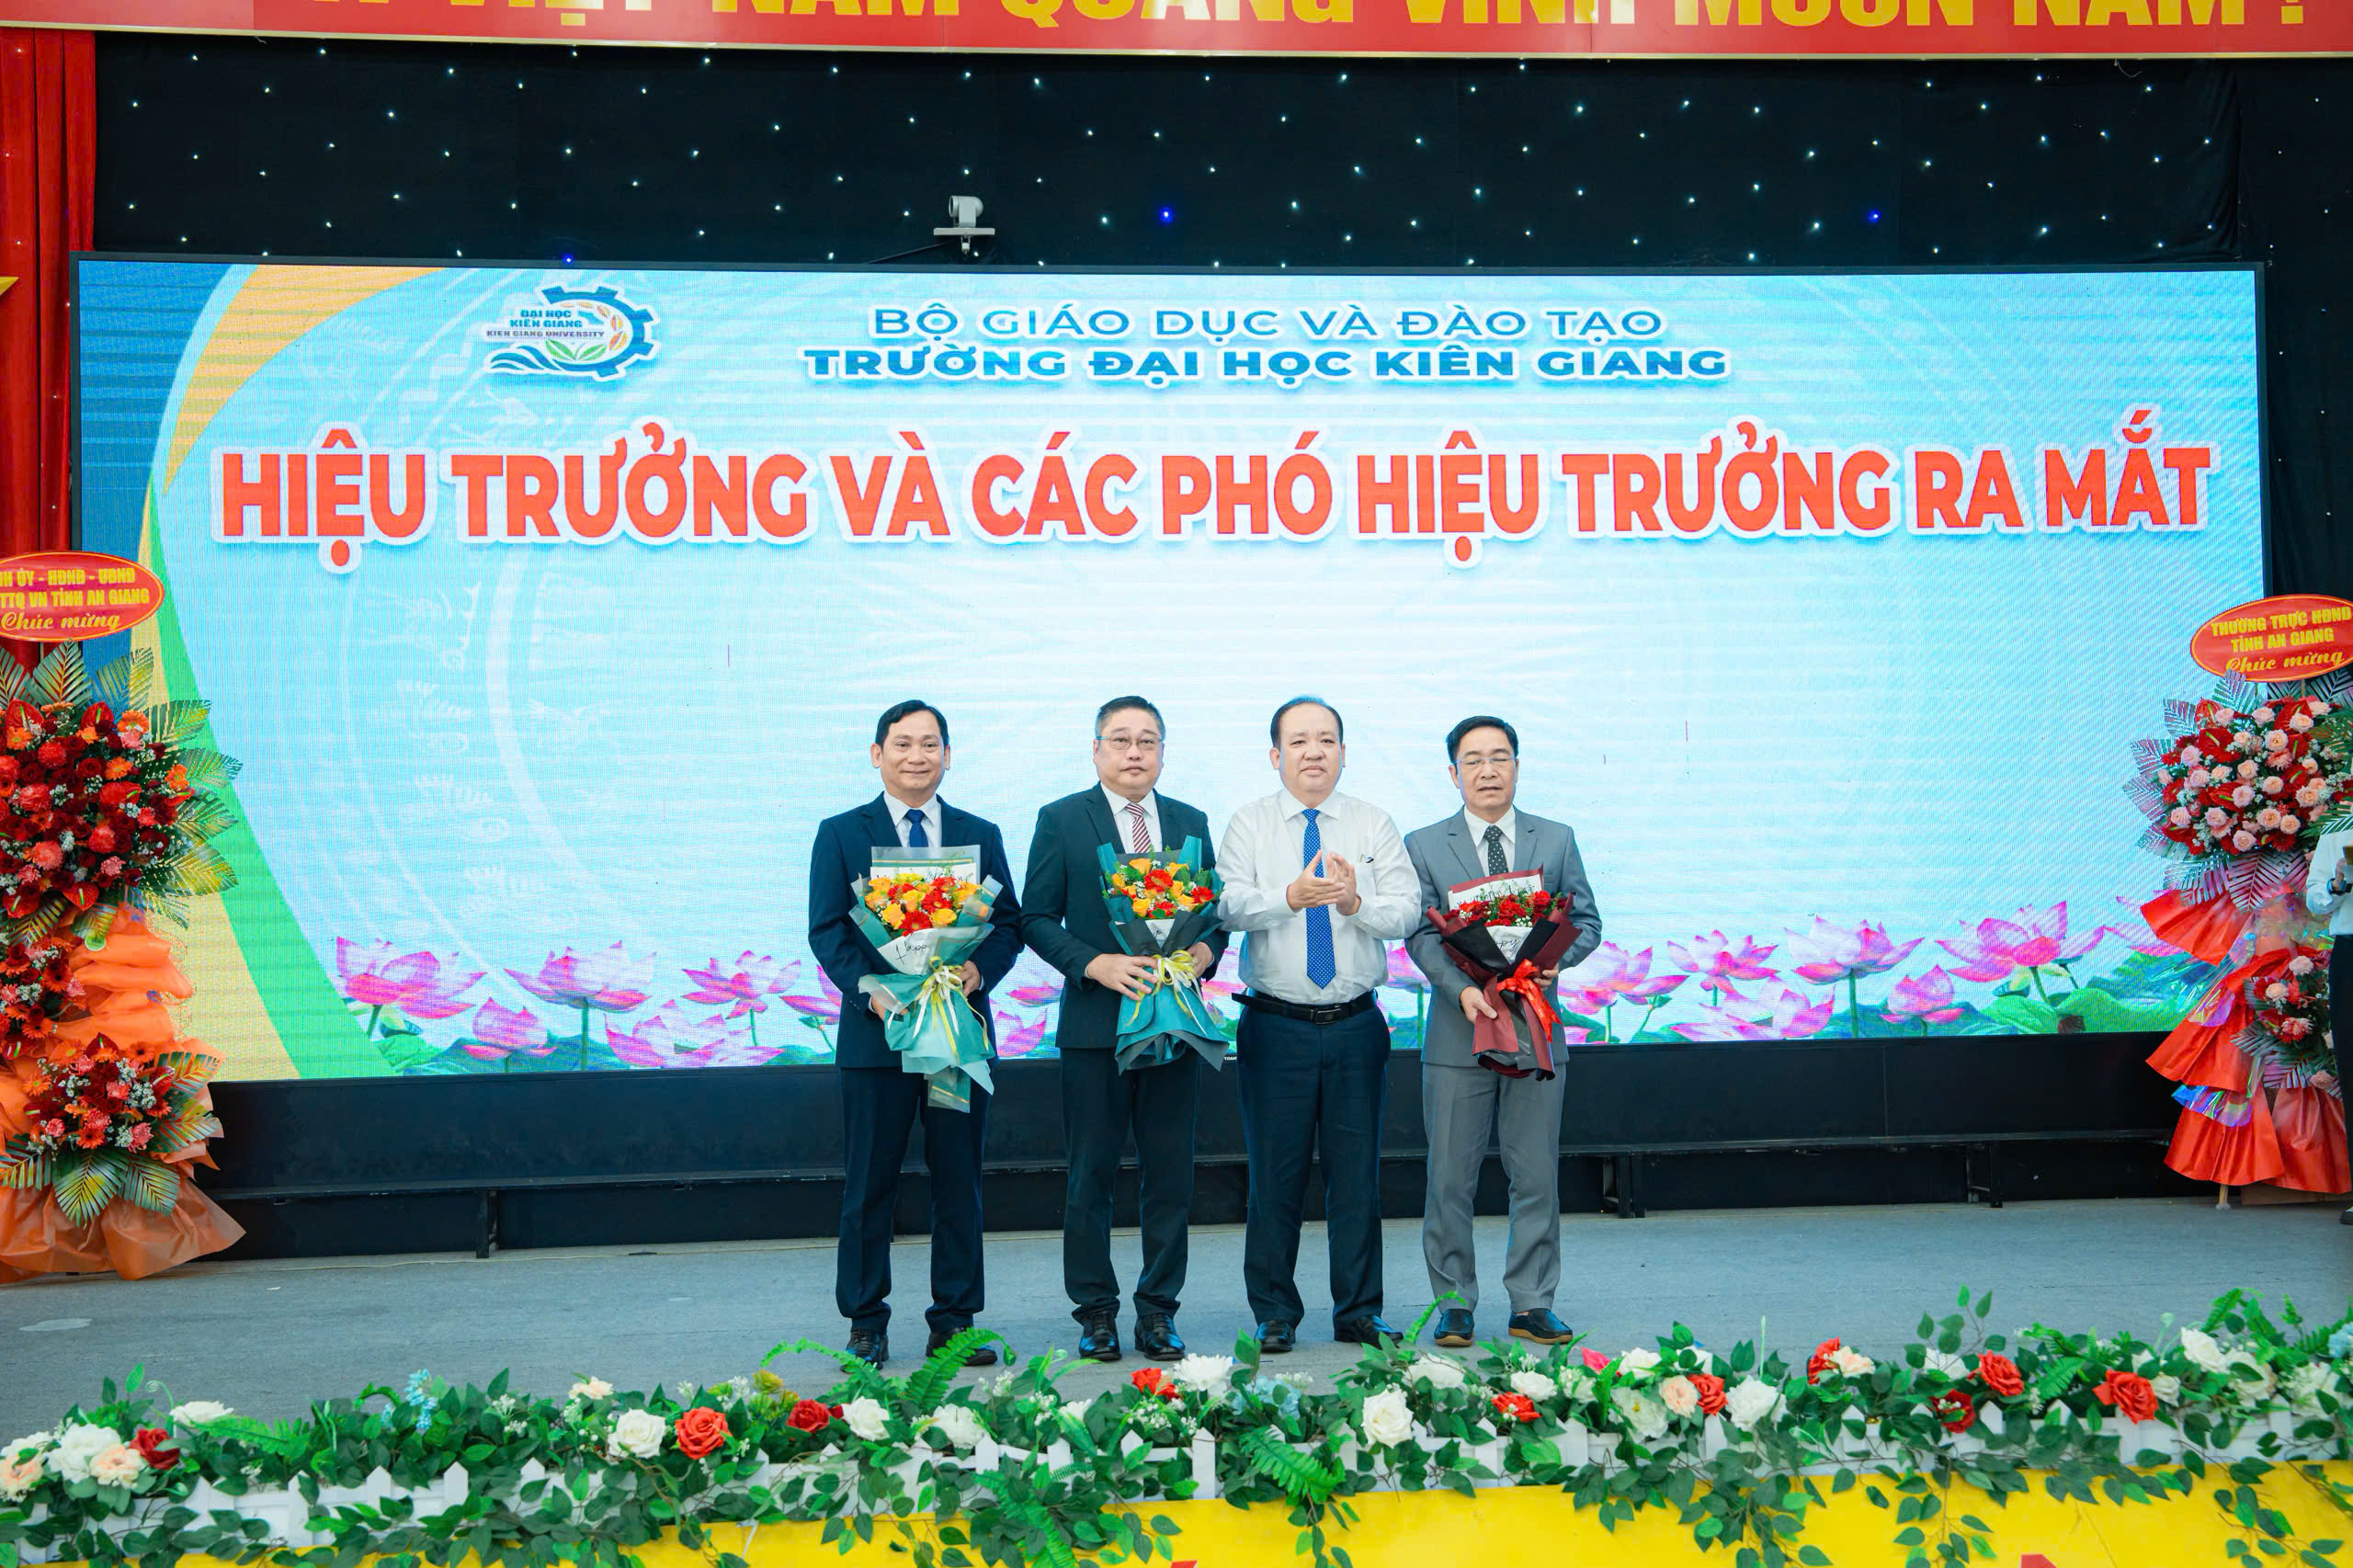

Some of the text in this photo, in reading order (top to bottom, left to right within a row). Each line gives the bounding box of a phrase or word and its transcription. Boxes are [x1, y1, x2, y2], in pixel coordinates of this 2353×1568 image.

[542, 319, 583, 328] GIANG
[875, 302, 1662, 343] BỘ GIÁO DỤC VÀ ĐÀO TẠO
[804, 344, 1726, 385] TRƯỜNG ĐẠI HỌC KIÊN GIANG
[222, 409, 2211, 567] HIỆU TRƯỞNG VÀ CÁC PHÓ HIỆU TRƯỞNG RA MẮT
[28, 591, 47, 608] VN
[86, 589, 105, 606] AN
[108, 588, 150, 605] GIANG
[1, 611, 120, 631] Chúc mừng
[2211, 617, 2267, 636] THƯỜNG
[2270, 610, 2308, 630] TRỰC
[2268, 632, 2286, 648] AN
[2290, 628, 2335, 646] GIANG
[2283, 651, 2345, 667] mừng
